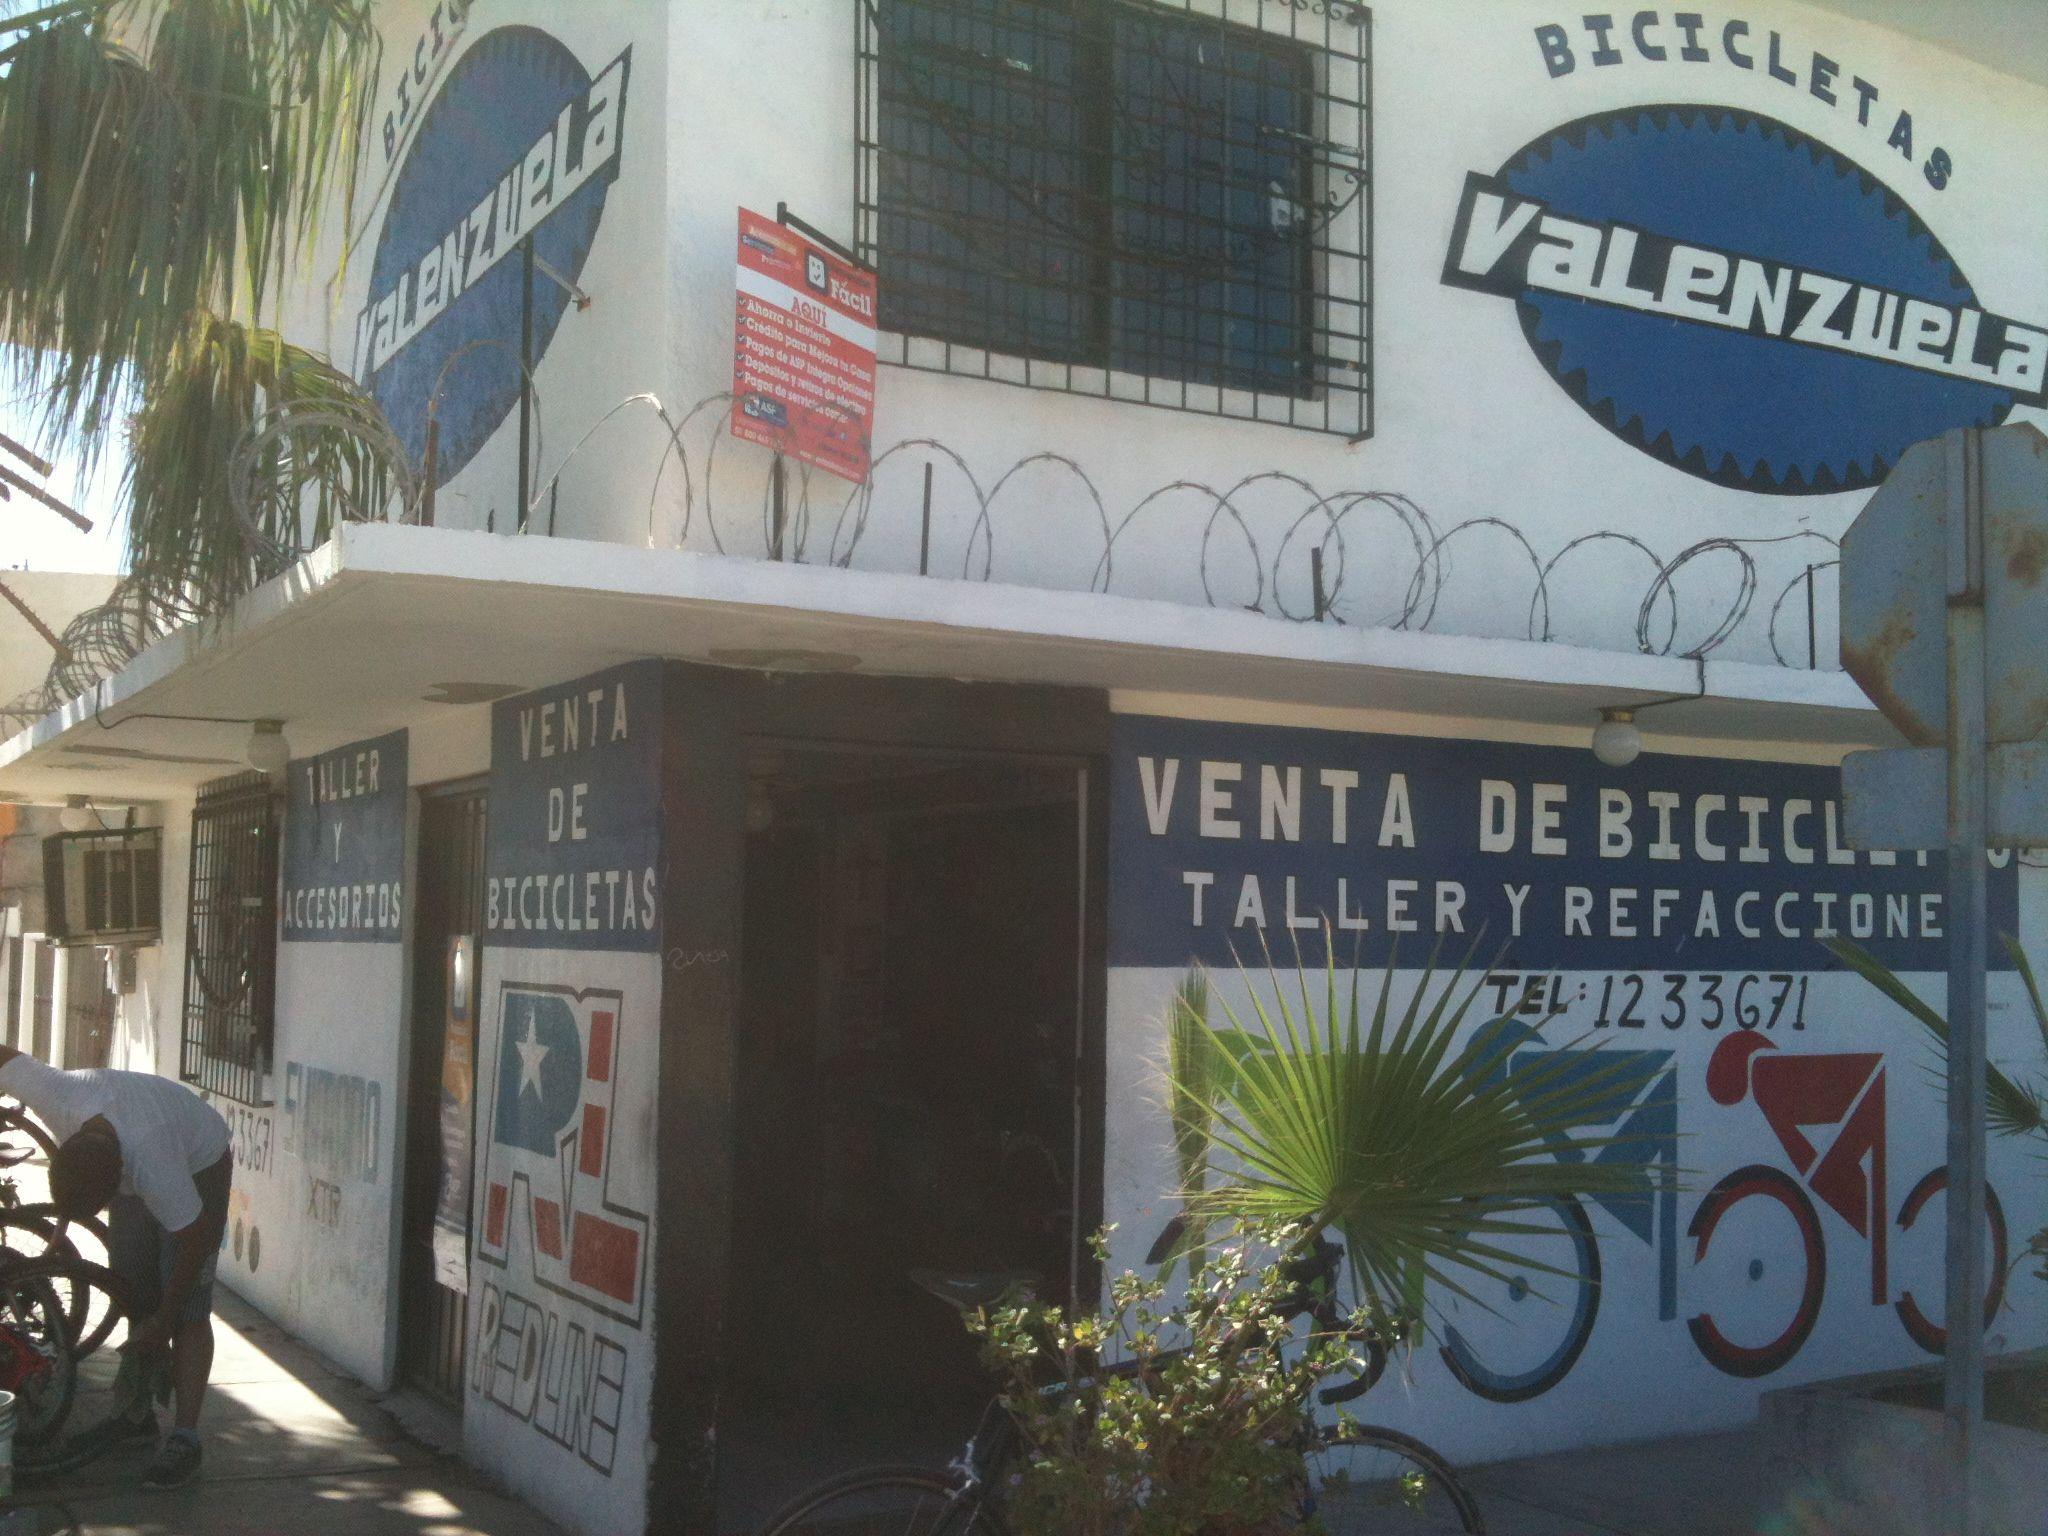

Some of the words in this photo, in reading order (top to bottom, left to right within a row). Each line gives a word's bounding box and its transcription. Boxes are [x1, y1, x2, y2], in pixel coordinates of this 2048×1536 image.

[1533, 10, 1953, 191] BICICLETAS
[746, 300, 784, 324] Ahorra
[745, 336, 775, 358] Pagos
[776, 350, 788, 364] de
[743, 371, 773, 393] Pagos
[774, 383, 787, 398] de
[519, 682, 628, 762] VENTA
[306, 749, 380, 806] TALLER
[547, 782, 589, 843] DE
[1137, 755, 1416, 848] VENTA
[1479, 778, 1568, 856] DE
[1599, 787, 2011, 869] BICICL
[333, 822, 342, 864] Y
[285, 881, 401, 930] ACCESORIOS
[487, 865, 656, 931] BICICLETAS
[1182, 870, 1467, 933] TALLER
[1502, 883, 1531, 937] Y
[1564, 886, 1944, 938] REFACCIONE
[1485, 974, 1587, 1016] TEL:
[1593, 973, 1808, 1031] 1233671
[471, 1280, 628, 1478] REDLINE
